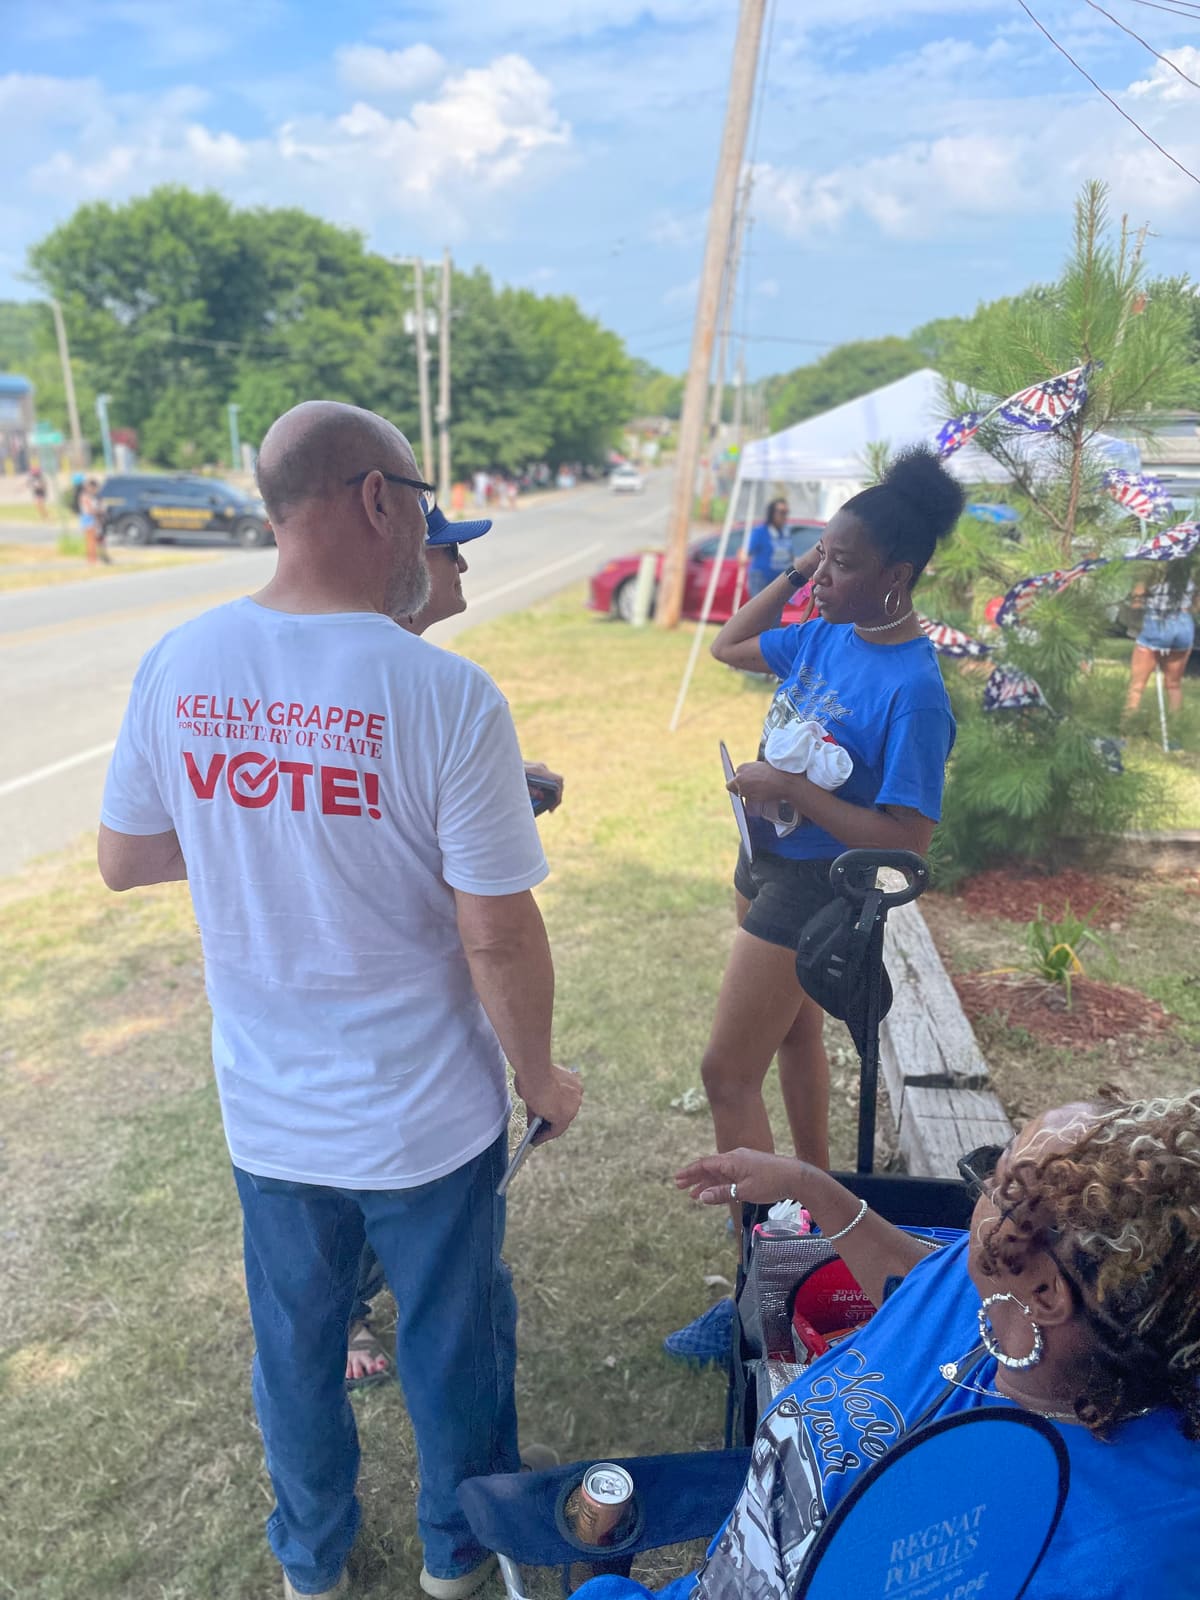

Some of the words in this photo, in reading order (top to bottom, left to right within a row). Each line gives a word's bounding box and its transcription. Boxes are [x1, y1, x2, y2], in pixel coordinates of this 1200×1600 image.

[176, 694, 261, 722] KELLY
[266, 701, 386, 741] GRAPPE
[178, 722, 193, 730] FOR
[192, 720, 291, 745] SECRETARY
[295, 730, 319, 747] OF
[321, 734, 383, 760] STATE
[183, 751, 383, 820] VOTE!
[890, 1503, 987, 1563] REGNAT
